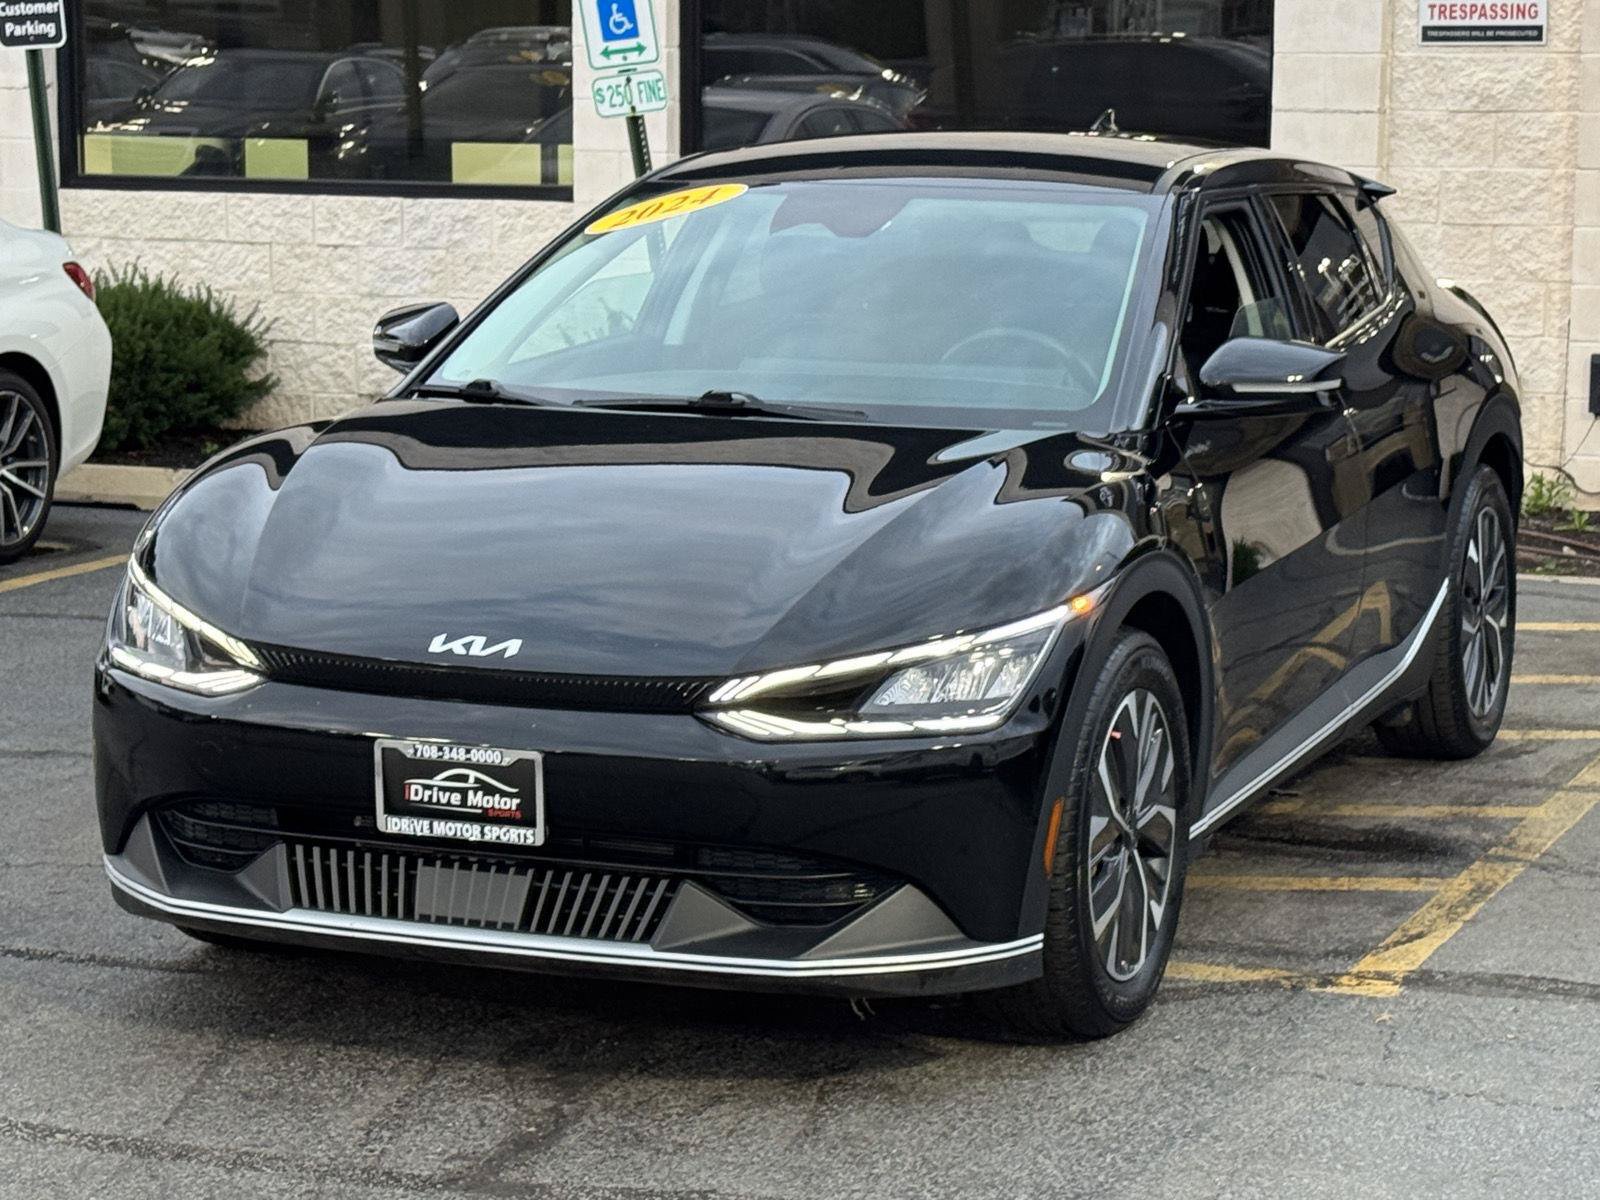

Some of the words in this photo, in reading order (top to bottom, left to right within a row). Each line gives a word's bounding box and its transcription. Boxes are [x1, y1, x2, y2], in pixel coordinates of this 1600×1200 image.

[0, 2, 59, 17] Customer
[1427, 3, 1539, 20] TRESPASSING
[5, 20, 56, 38] Parking
[637, 79, 667, 103] FINE
[608, 187, 721, 229] 2024
[427, 632, 523, 659] KIA
[415, 744, 502, 764] 708-348-0000
[404, 783, 461, 805] iDrive
[467, 789, 521, 811] Motor
[486, 808, 522, 819] SPORTS
[432, 820, 482, 840] MOTOR
[483, 825, 535, 844] SPORTS
